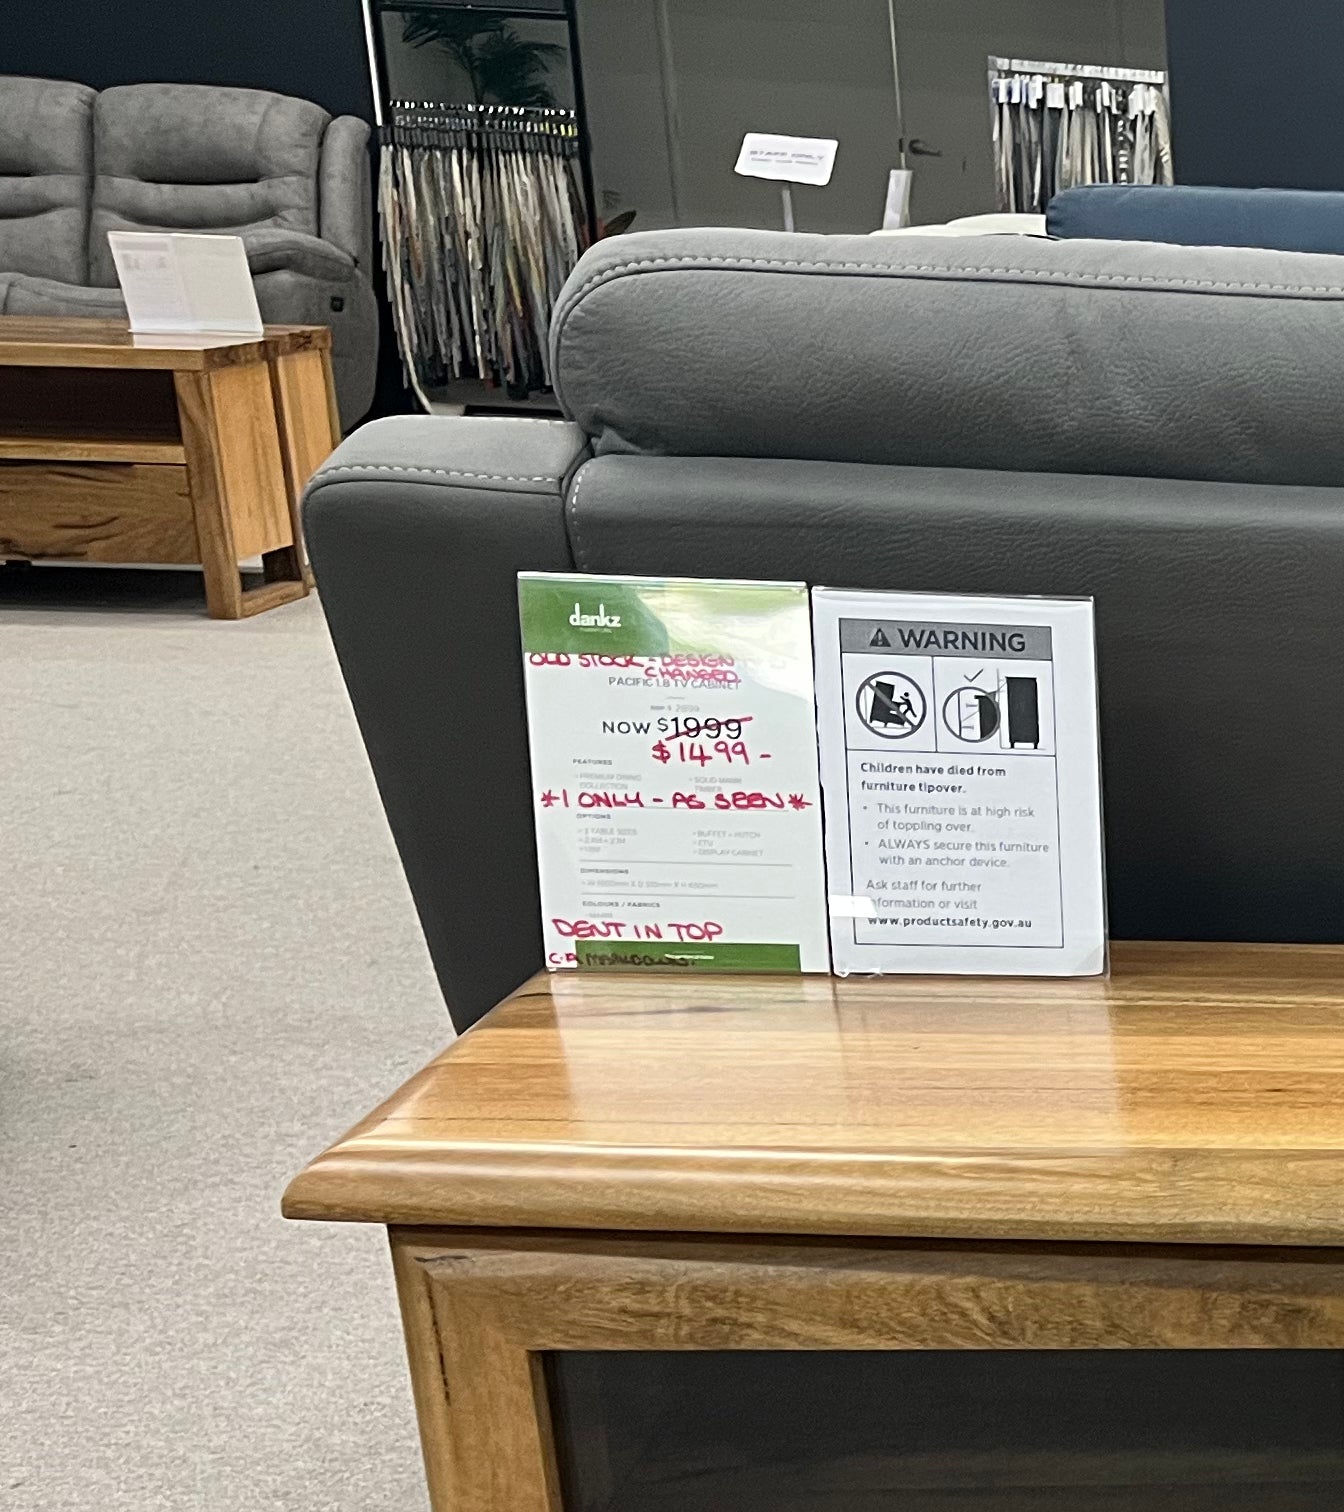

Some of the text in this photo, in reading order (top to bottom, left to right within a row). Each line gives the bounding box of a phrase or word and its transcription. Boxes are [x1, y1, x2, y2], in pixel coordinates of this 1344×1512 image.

[569, 602, 621, 627] dankz
[898, 628, 1026, 652] WARNING
[529, 653, 571, 666] OLD
[660, 653, 735, 667] DESIGN
[608, 676, 653, 687] PACIFIC
[674, 679, 688, 688] TV
[602, 716, 742, 739] NOW $1999
[652, 740, 749, 767] $1499
[861, 763, 1006, 777] Children have died from
[861, 781, 967, 794] furniture tipover.
[578, 791, 645, 808] ONLY
[672, 792, 706, 809] AS
[877, 803, 1034, 818] This furniture is at high risk
[877, 820, 974, 832] of toppling over.
[878, 840, 1049, 852] ALWAYS secure this furniture
[879, 855, 1010, 867] with an anchor device.
[867, 880, 982, 891] Ask staff for further
[938, 900, 950, 908] or
[954, 899, 978, 909] visit
[552, 918, 723, 941] DENT IN TOP
[868, 918, 1032, 929] www.productsafety.gov.au
